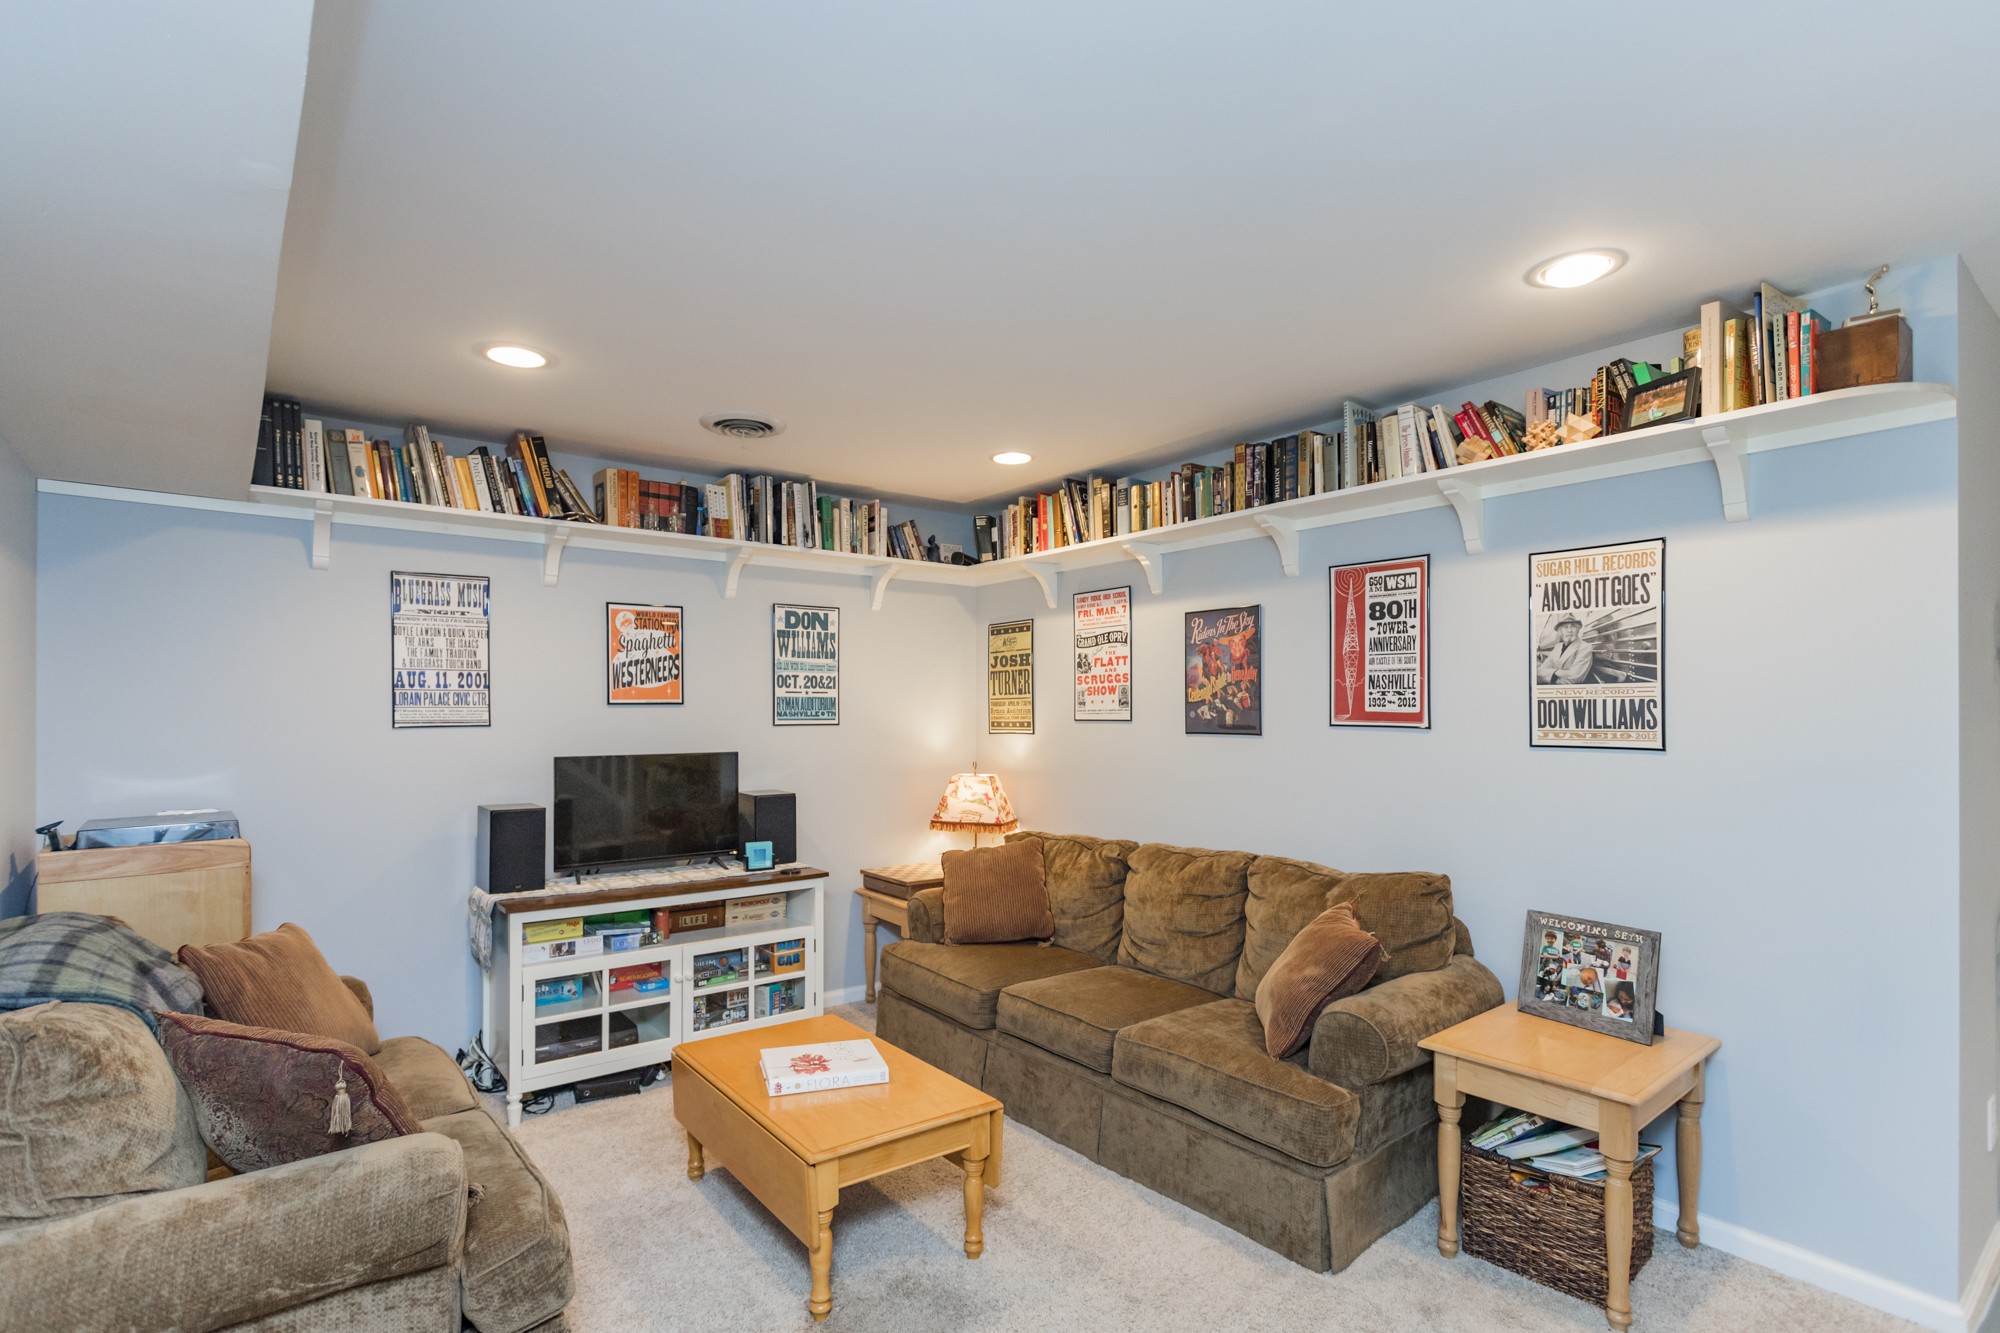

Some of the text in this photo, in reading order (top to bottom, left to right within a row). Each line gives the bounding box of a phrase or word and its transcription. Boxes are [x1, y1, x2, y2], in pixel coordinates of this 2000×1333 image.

[471, 457, 482, 485] Dutch
[539, 457, 553, 489] GRACELAND
[1536, 551, 1657, 578] SUGAR HILL RECORDS
[1369, 576, 1382, 587] 650
[1386, 574, 1416, 590] WSM
[394, 578, 489, 617] BLUEGRASS MUSIC
[1112, 591, 1126, 599] SCHOOL
[1573, 578, 1591, 610] SO
[1595, 577, 1609, 608] IT
[1078, 605, 1126, 618] FRI. MAR. 7
[1369, 599, 1417, 621] 80TH
[634, 618, 679, 632] STATION INN
[785, 610, 828, 631] DON
[1376, 620, 1408, 635] TOWER
[394, 626, 414, 636] DOYLE
[416, 627, 441, 637] LAWSON
[448, 628, 465, 638] QUICK
[468, 629, 488, 639] SILVER
[1191, 611, 1255, 645] Riders In The Sky
[405, 637, 415, 646] THE
[446, 638, 456, 648] THE
[458, 639, 479, 648] ISAACS
[617, 629, 675, 658] Spaghetti
[777, 630, 836, 659] WILLIAMS
[1078, 632, 1126, 647] GRAND OLE OPRY
[1369, 635, 1416, 652] ANNIVERSARY
[407, 648, 477, 658] THE FAMILY TRADITION
[1376, 656, 1390, 665] CASTLE
[1404, 655, 1416, 664] SOUTH
[409, 658, 443, 668] BLUEGRASS
[446, 659, 464, 668] TOUCH
[466, 659, 481, 669] BAND
[991, 653, 1030, 668] JOSH
[1094, 656, 1128, 668] FLATT
[612, 654, 680, 690] WESTERNEERS
[1077, 673, 1129, 685] SCRUGGS
[394, 671, 489, 689] AUG. 11, 2001
[777, 675, 836, 689] OCT. 20&21
[990, 669, 1030, 696] TURNER
[1369, 674, 1416, 690] NASHVILLE
[1087, 685, 1117, 696] SHOW
[394, 692, 489, 706] LORAIN PALACE CIVIC CTR.
[800, 697, 836, 711] AUDITORIUM
[1369, 697, 1416, 708] 1932 2012
[1538, 699, 1657, 730] DON WILLIAMS
[1538, 731, 1608, 739] JUNE
[741, 898, 771, 907] MONOPOLY
[684, 915, 706, 925] LIFE
[1539, 917, 1644, 944] WELCOMING SETH
[583, 937, 602, 945] 1500
[777, 953, 800, 966] GAB
[722, 1009, 745, 1020] Clue
[807, 1075, 850, 1090] FLORA
